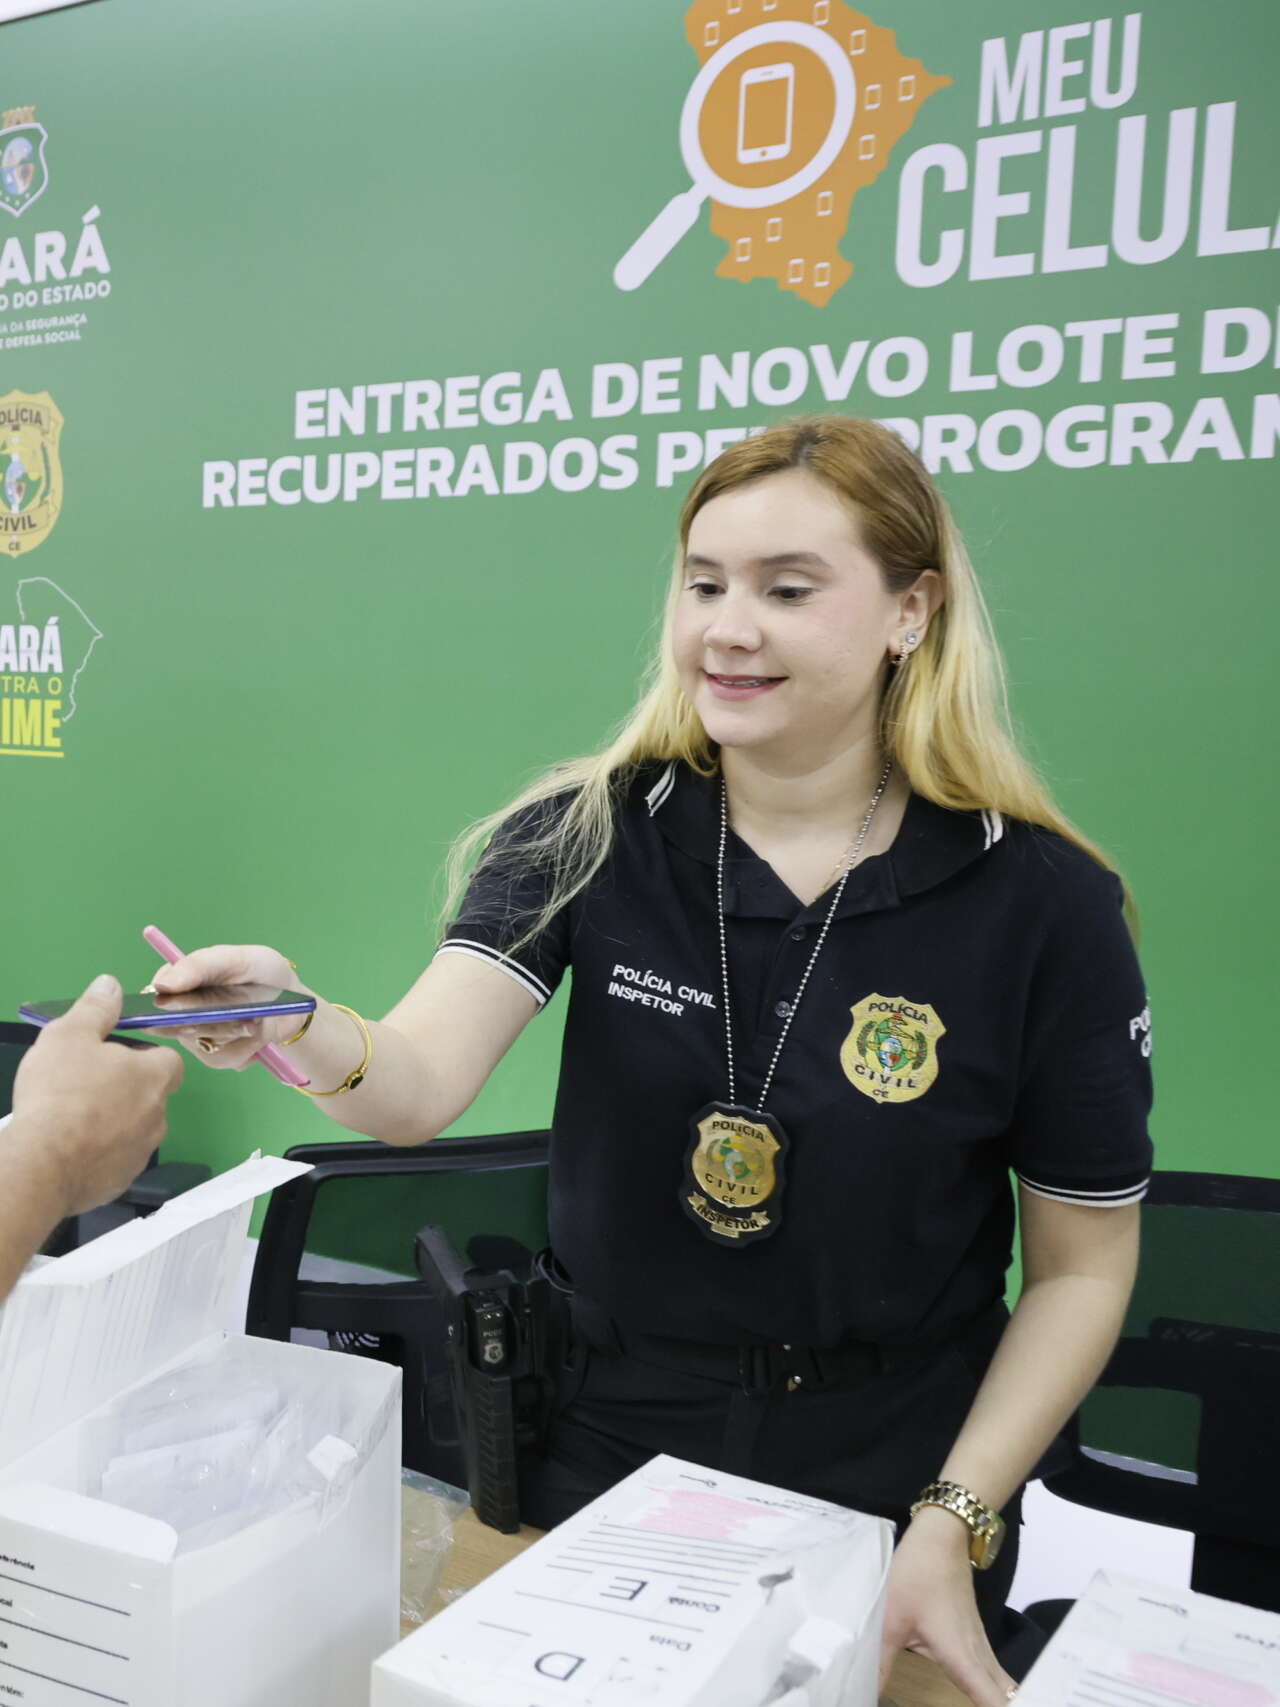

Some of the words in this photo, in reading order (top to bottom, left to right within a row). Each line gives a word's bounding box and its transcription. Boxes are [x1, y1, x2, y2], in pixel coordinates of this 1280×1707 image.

[977, 12, 1142, 128] MEU
[895, 100, 1280, 289] CELUL
[13, 290, 38, 309] DO
[43, 279, 111, 305] ESTADO
[10, 321, 24, 333] DA
[26, 313, 87, 332] SEGURANÇA
[6, 333, 41, 349] DEFESA
[44, 329, 81, 345] SOCIAL
[294, 368, 573, 440] ENTREGA
[591, 356, 683, 419] DE
[698, 336, 929, 412] NOVO
[949, 313, 1180, 393] LOTE
[1200, 305, 1280, 374] D
[202, 434, 639, 508] RECUPERADOS
[8, 541, 21, 551] CE
[47, 676, 62, 695] O
[607, 981, 684, 1017] INSPETOR
[612, 964, 673, 995] POLÍCIA
[677, 985, 717, 1009] CIVIL
[854, 1064, 917, 1088] CIVIL
[872, 1088, 889, 1098] CE
[705, 1173, 759, 1195] CIVIL
[722, 1195, 737, 1205] CE
[696, 1203, 760, 1230] INSPETOR
[599, 1575, 648, 1601] E
[649, 1634, 692, 1652] Data
[534, 1651, 587, 1682] D
